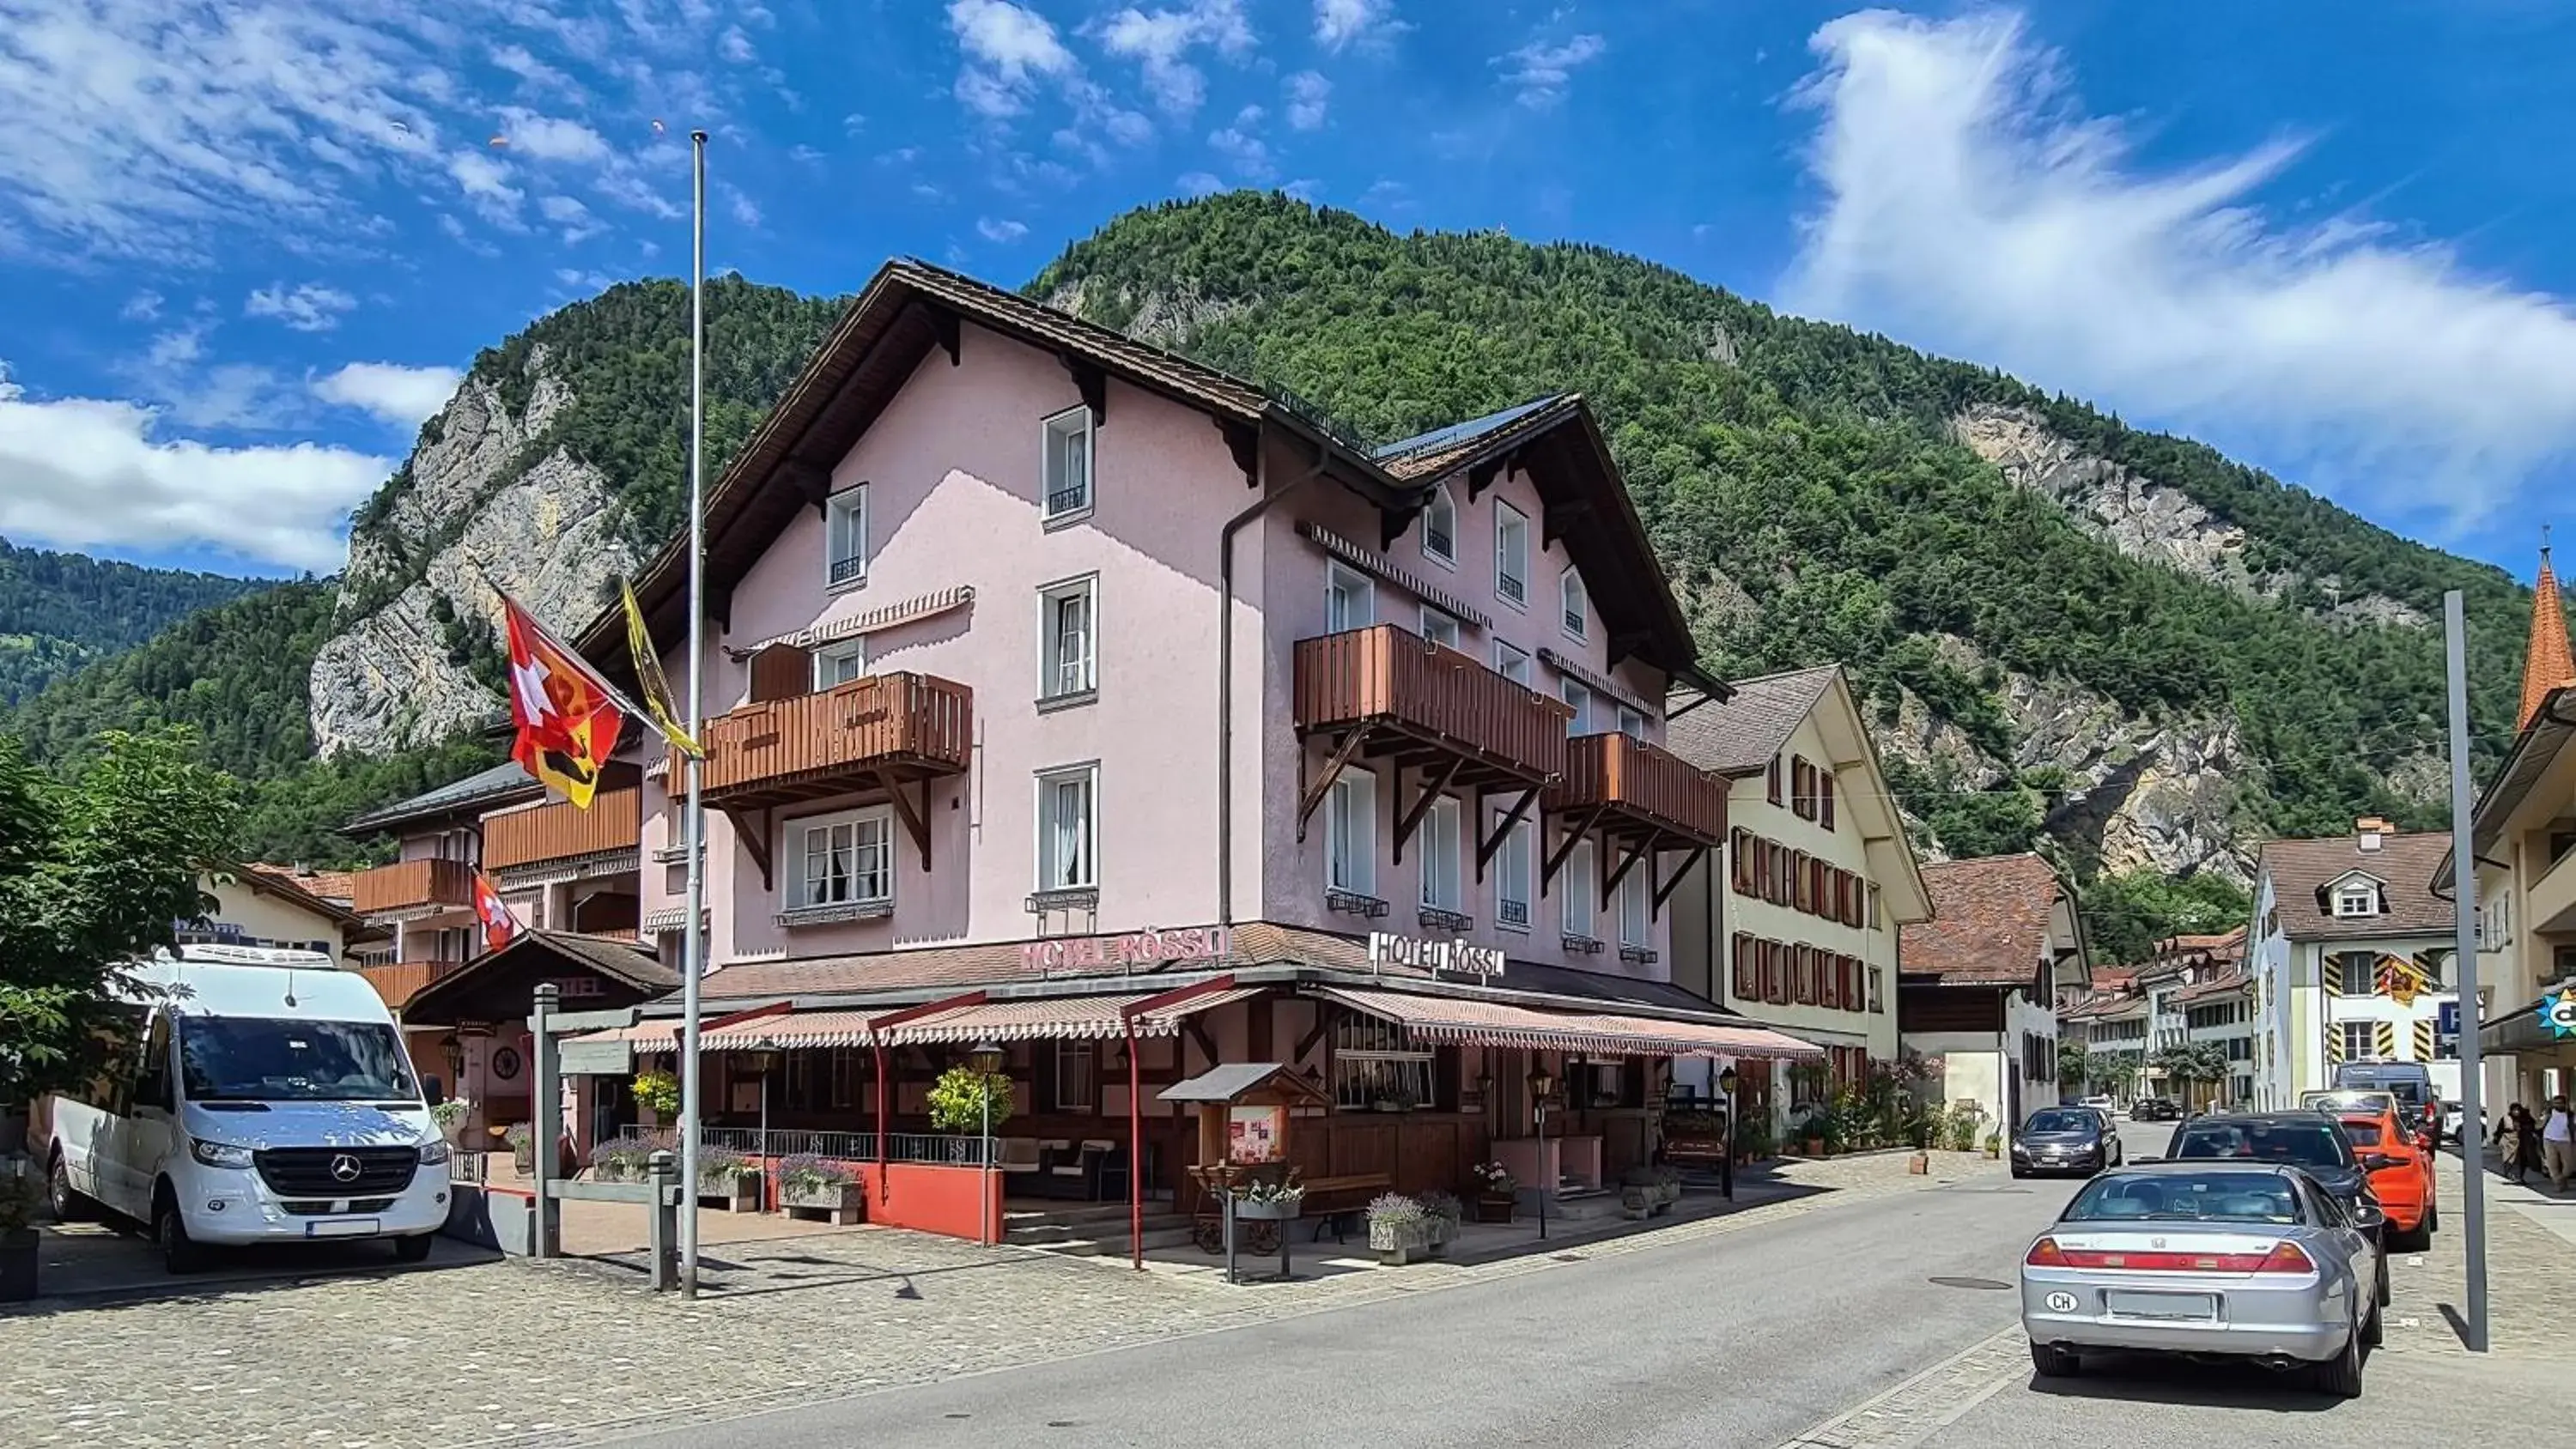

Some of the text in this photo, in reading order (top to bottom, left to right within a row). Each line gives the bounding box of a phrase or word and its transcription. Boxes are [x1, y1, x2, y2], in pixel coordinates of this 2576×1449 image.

[1020, 925, 1227, 970] HOTEL RÖSSLI
[1370, 931, 1443, 967] HOTEL
[2053, 1294, 2070, 1309] CH
